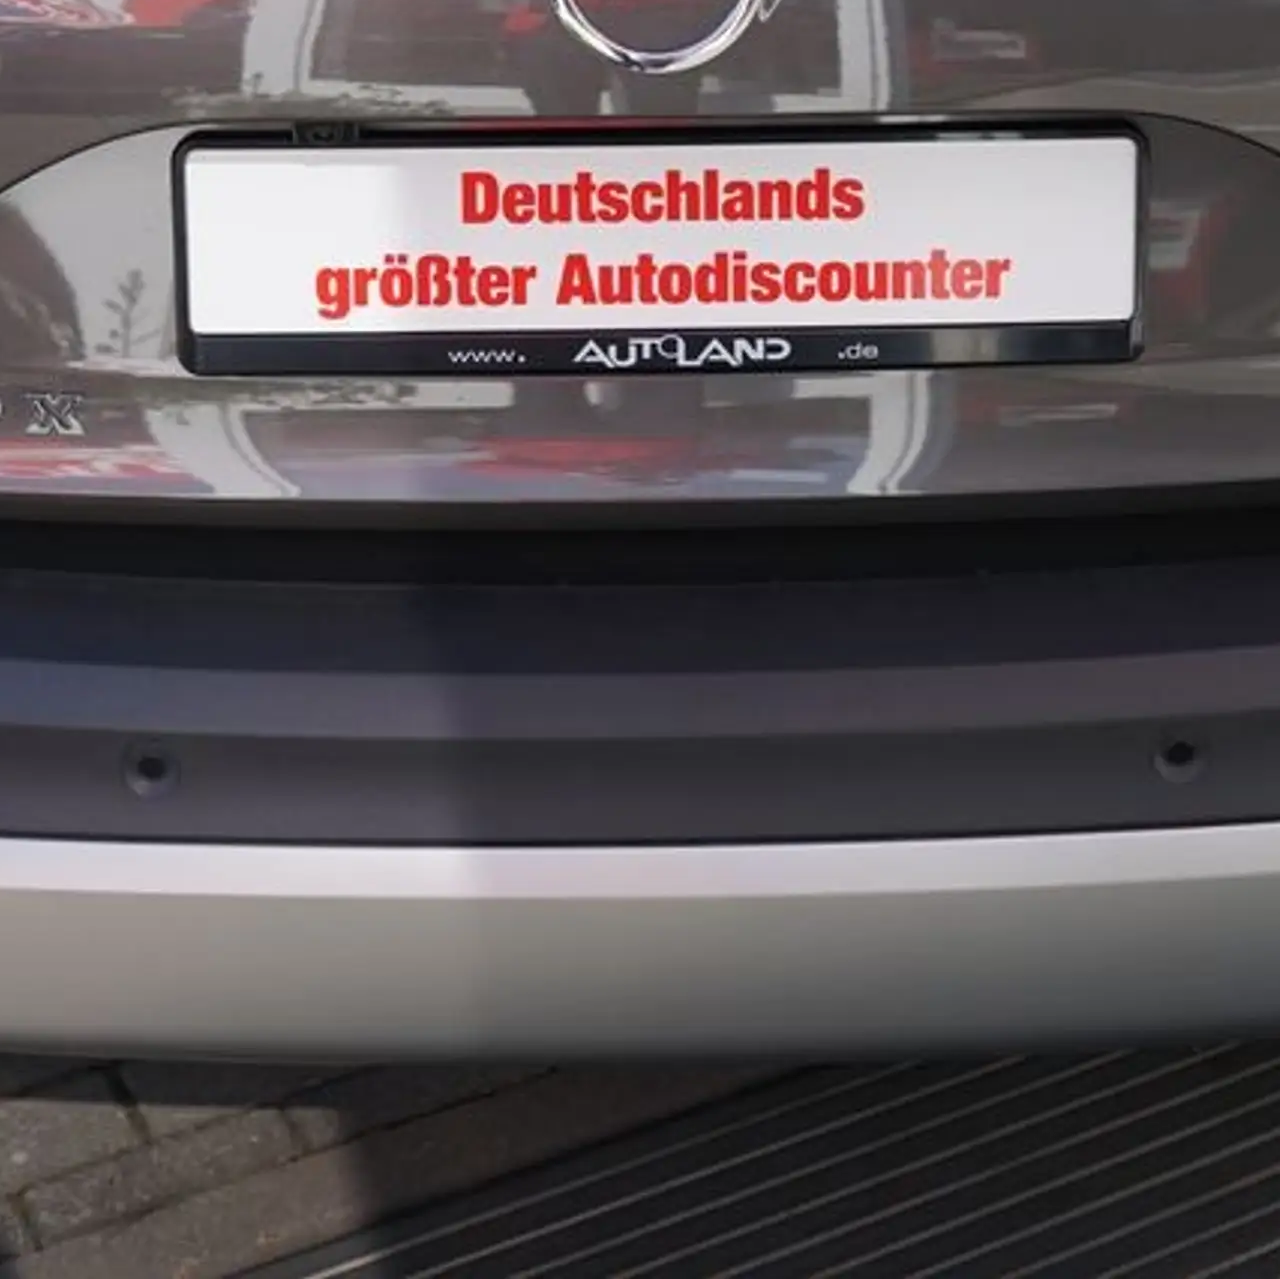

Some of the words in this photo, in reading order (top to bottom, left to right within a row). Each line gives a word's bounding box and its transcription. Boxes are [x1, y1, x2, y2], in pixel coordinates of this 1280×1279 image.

[461, 169, 865, 223] Deutschlands
[316, 254, 536, 319] größter
[557, 250, 1011, 305] Autodiscounter
[25, 393, 86, 436] X
